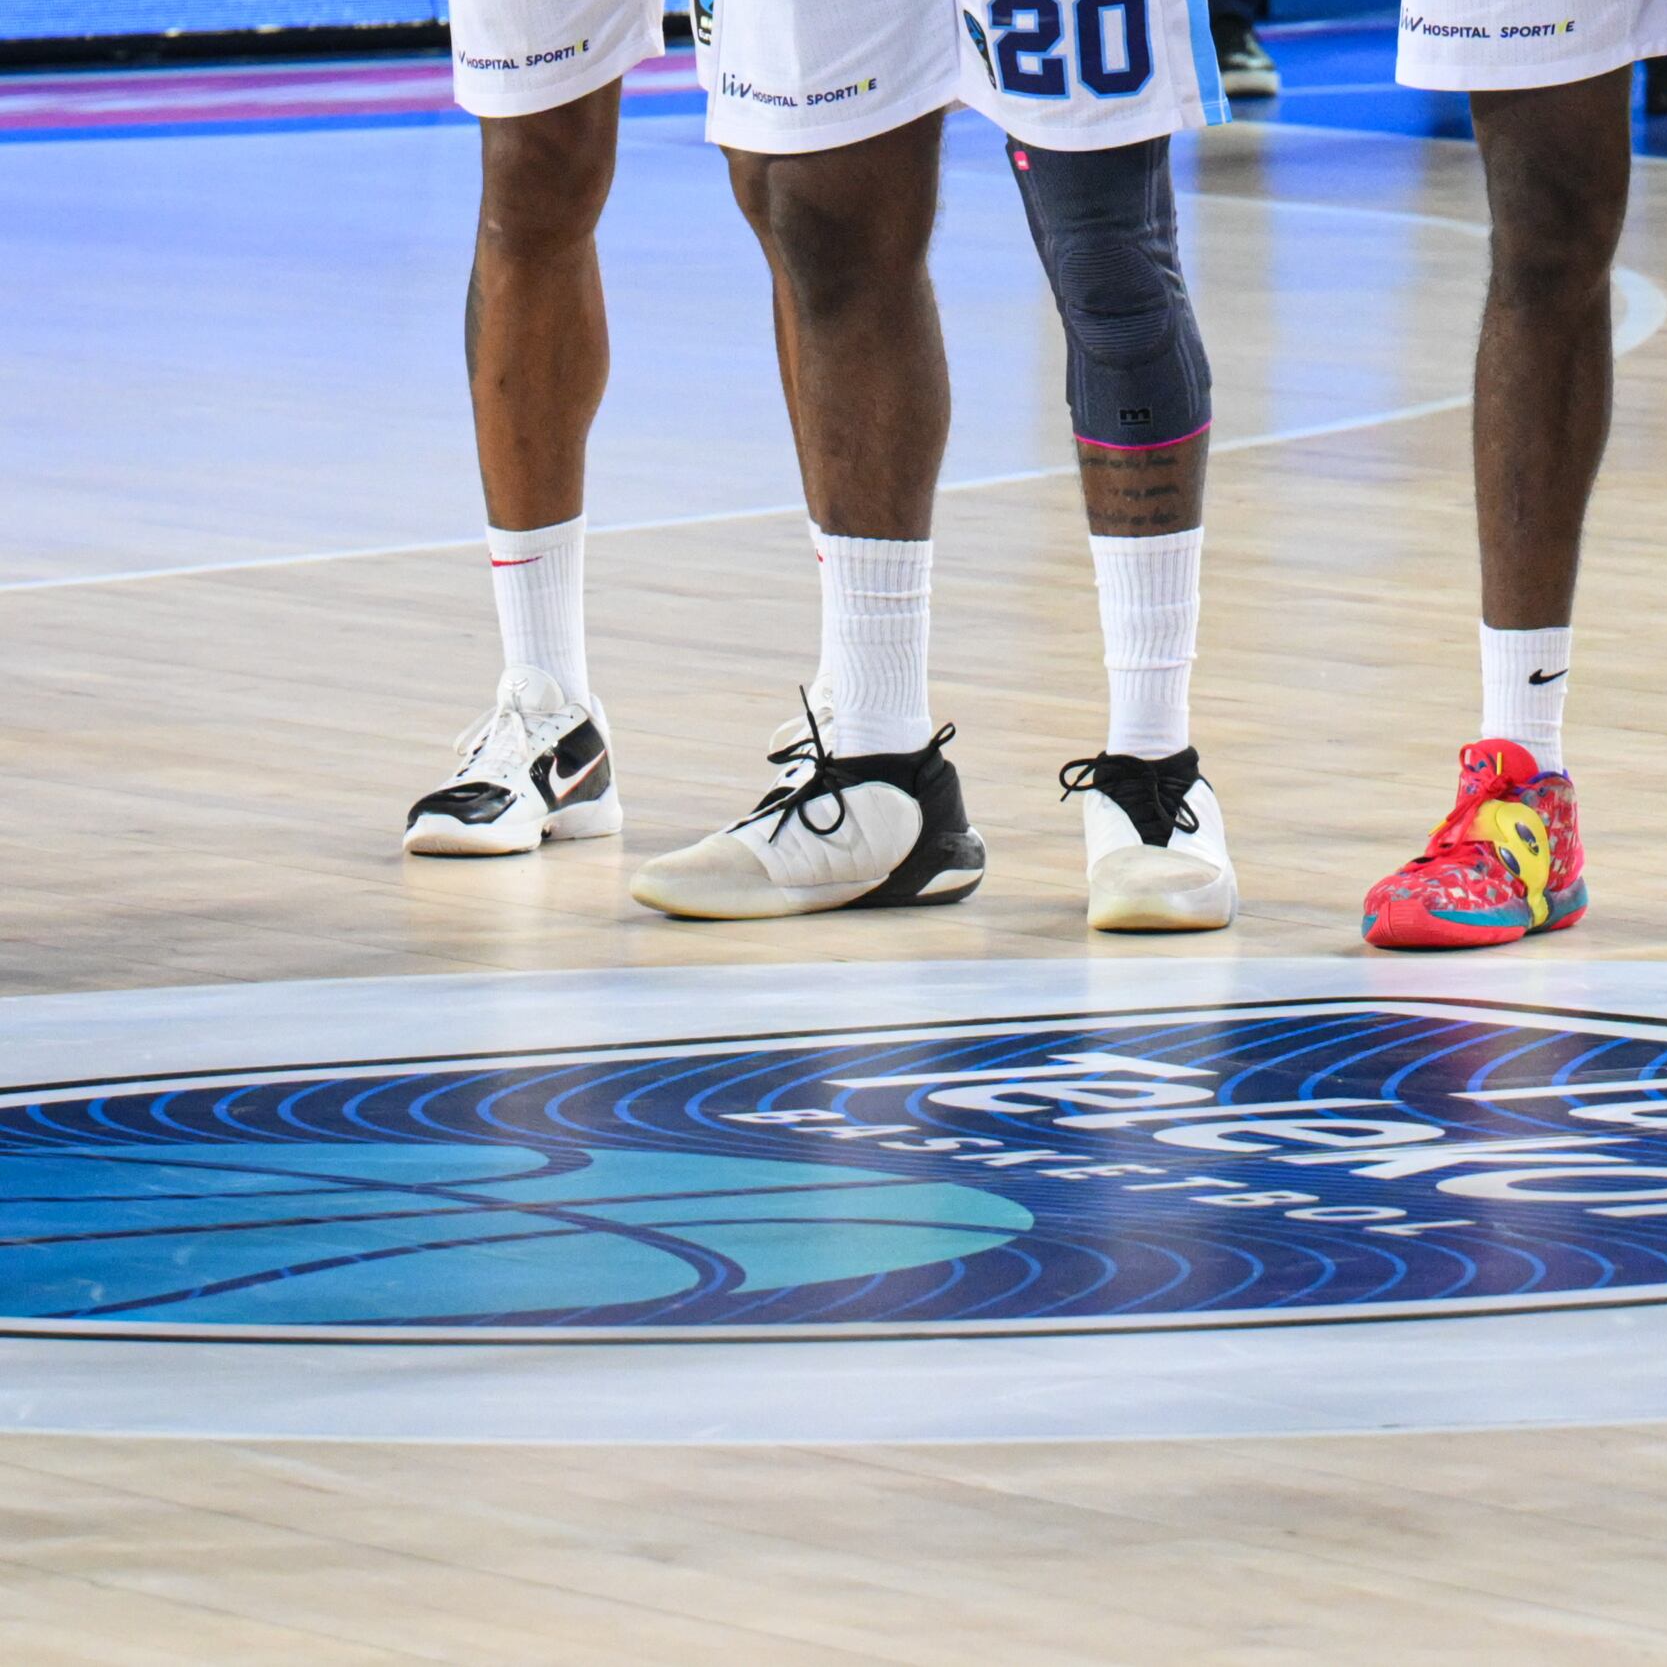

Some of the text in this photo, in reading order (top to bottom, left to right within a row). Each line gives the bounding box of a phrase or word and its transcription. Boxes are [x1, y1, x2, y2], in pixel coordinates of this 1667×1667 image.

[1422, 24, 1491, 39] HOSPITAL
[751, 90, 799, 109] HOSPITAL
[719, 1107, 1479, 1237] BASKETBOL
